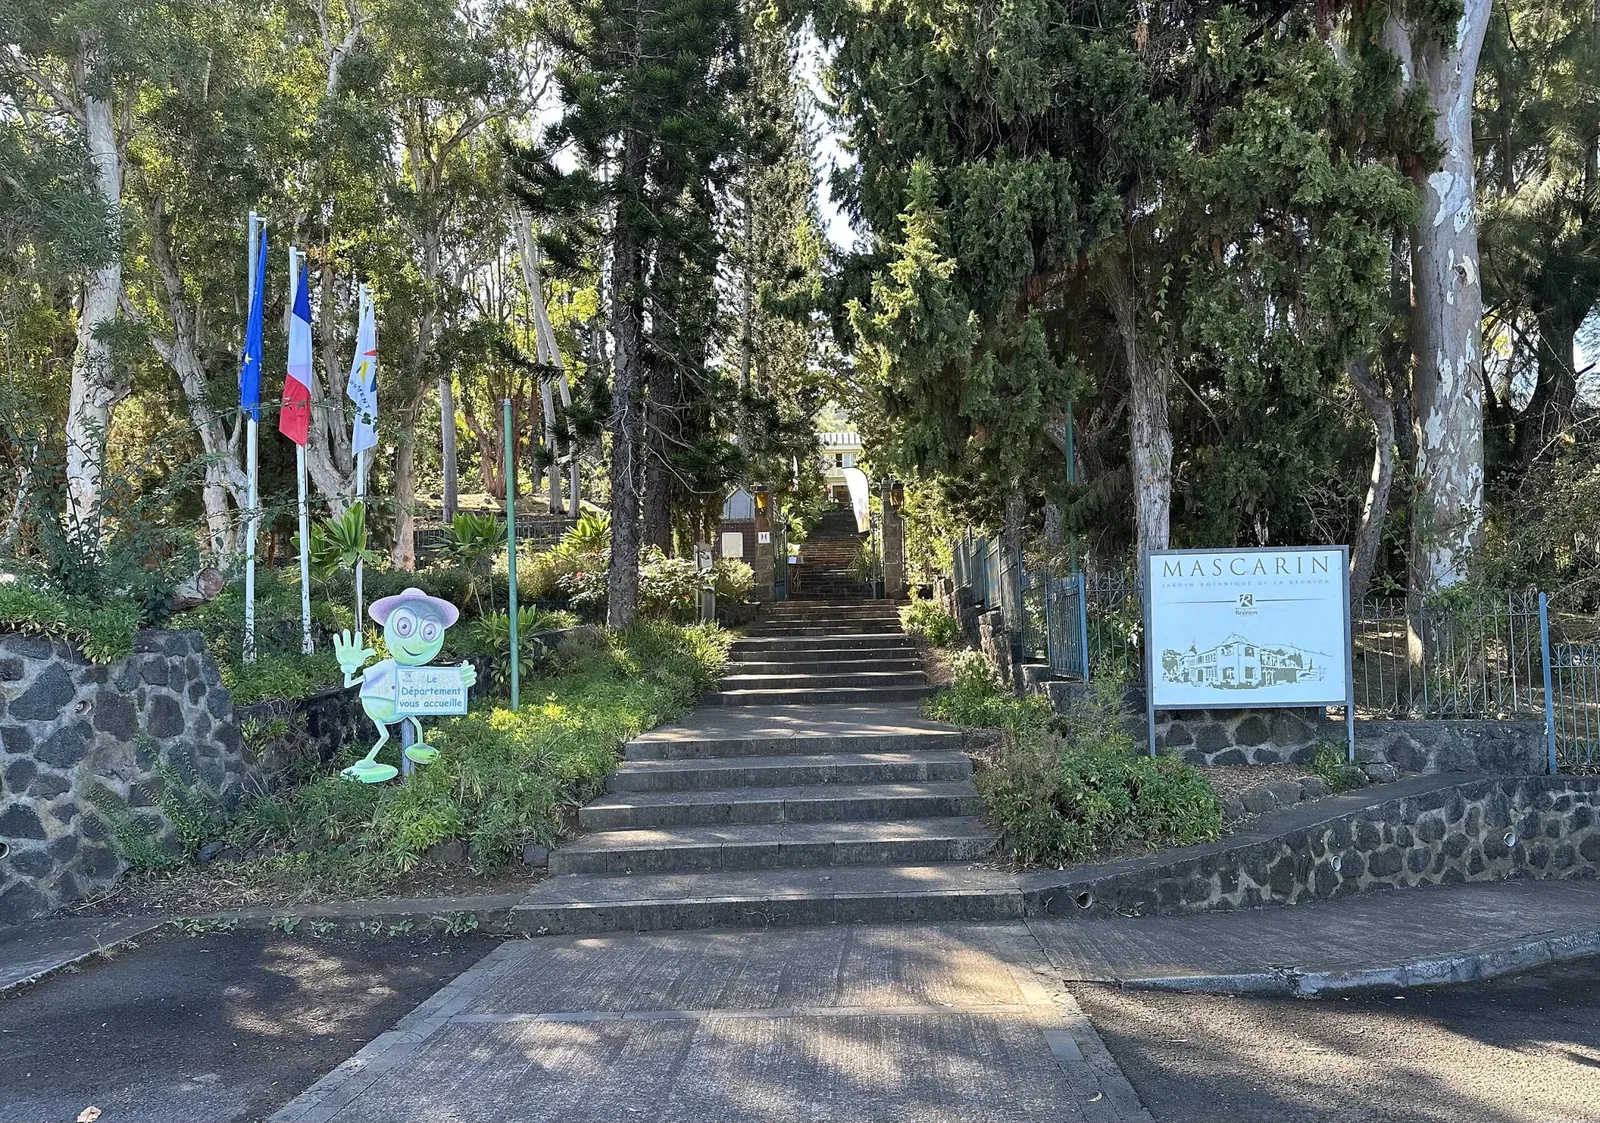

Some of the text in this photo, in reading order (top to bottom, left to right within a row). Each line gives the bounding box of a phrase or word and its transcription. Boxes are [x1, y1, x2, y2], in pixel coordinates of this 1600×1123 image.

[1162, 556, 1329, 577] MASCARIN
[426, 675, 438, 683] Le
[401, 687, 461, 697] Département
[399, 699, 463, 708] vous accueille
